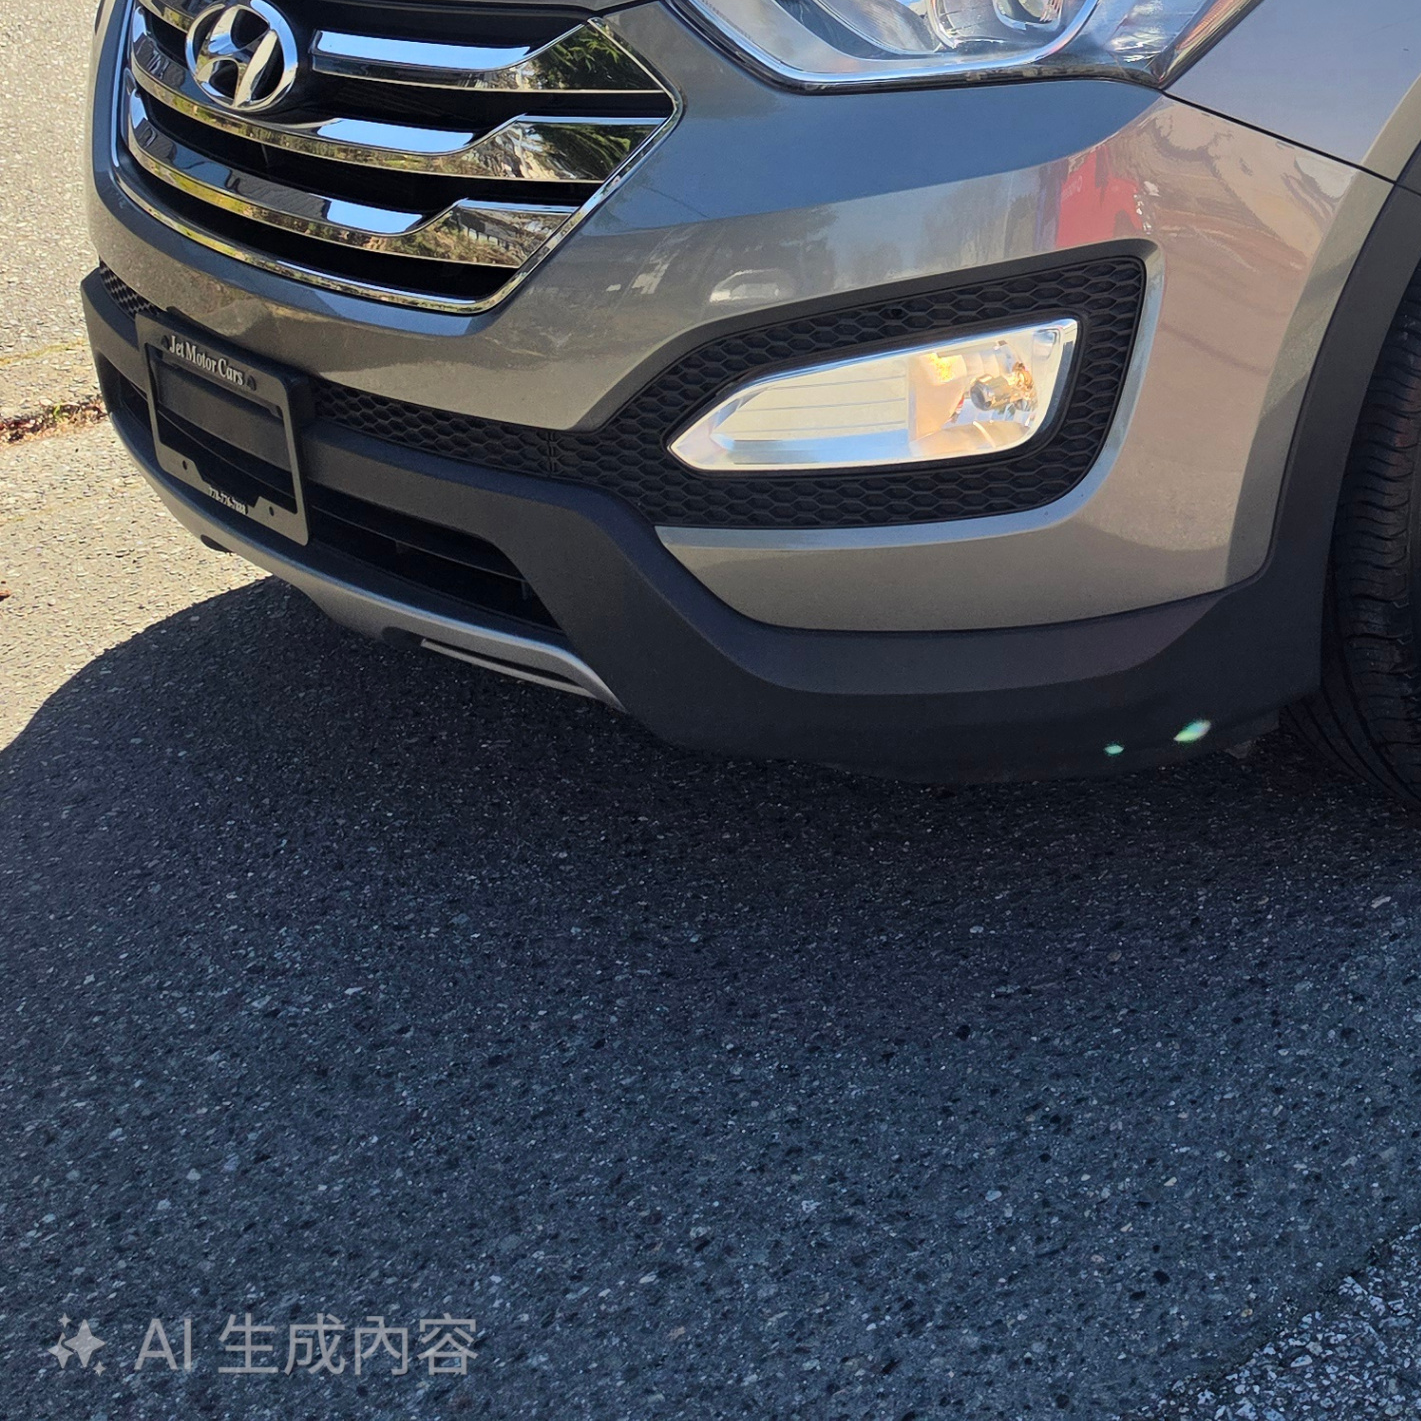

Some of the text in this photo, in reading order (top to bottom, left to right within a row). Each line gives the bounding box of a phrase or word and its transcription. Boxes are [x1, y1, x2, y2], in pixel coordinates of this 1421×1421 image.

[169, 335, 243, 385] Jet Motor Cars
